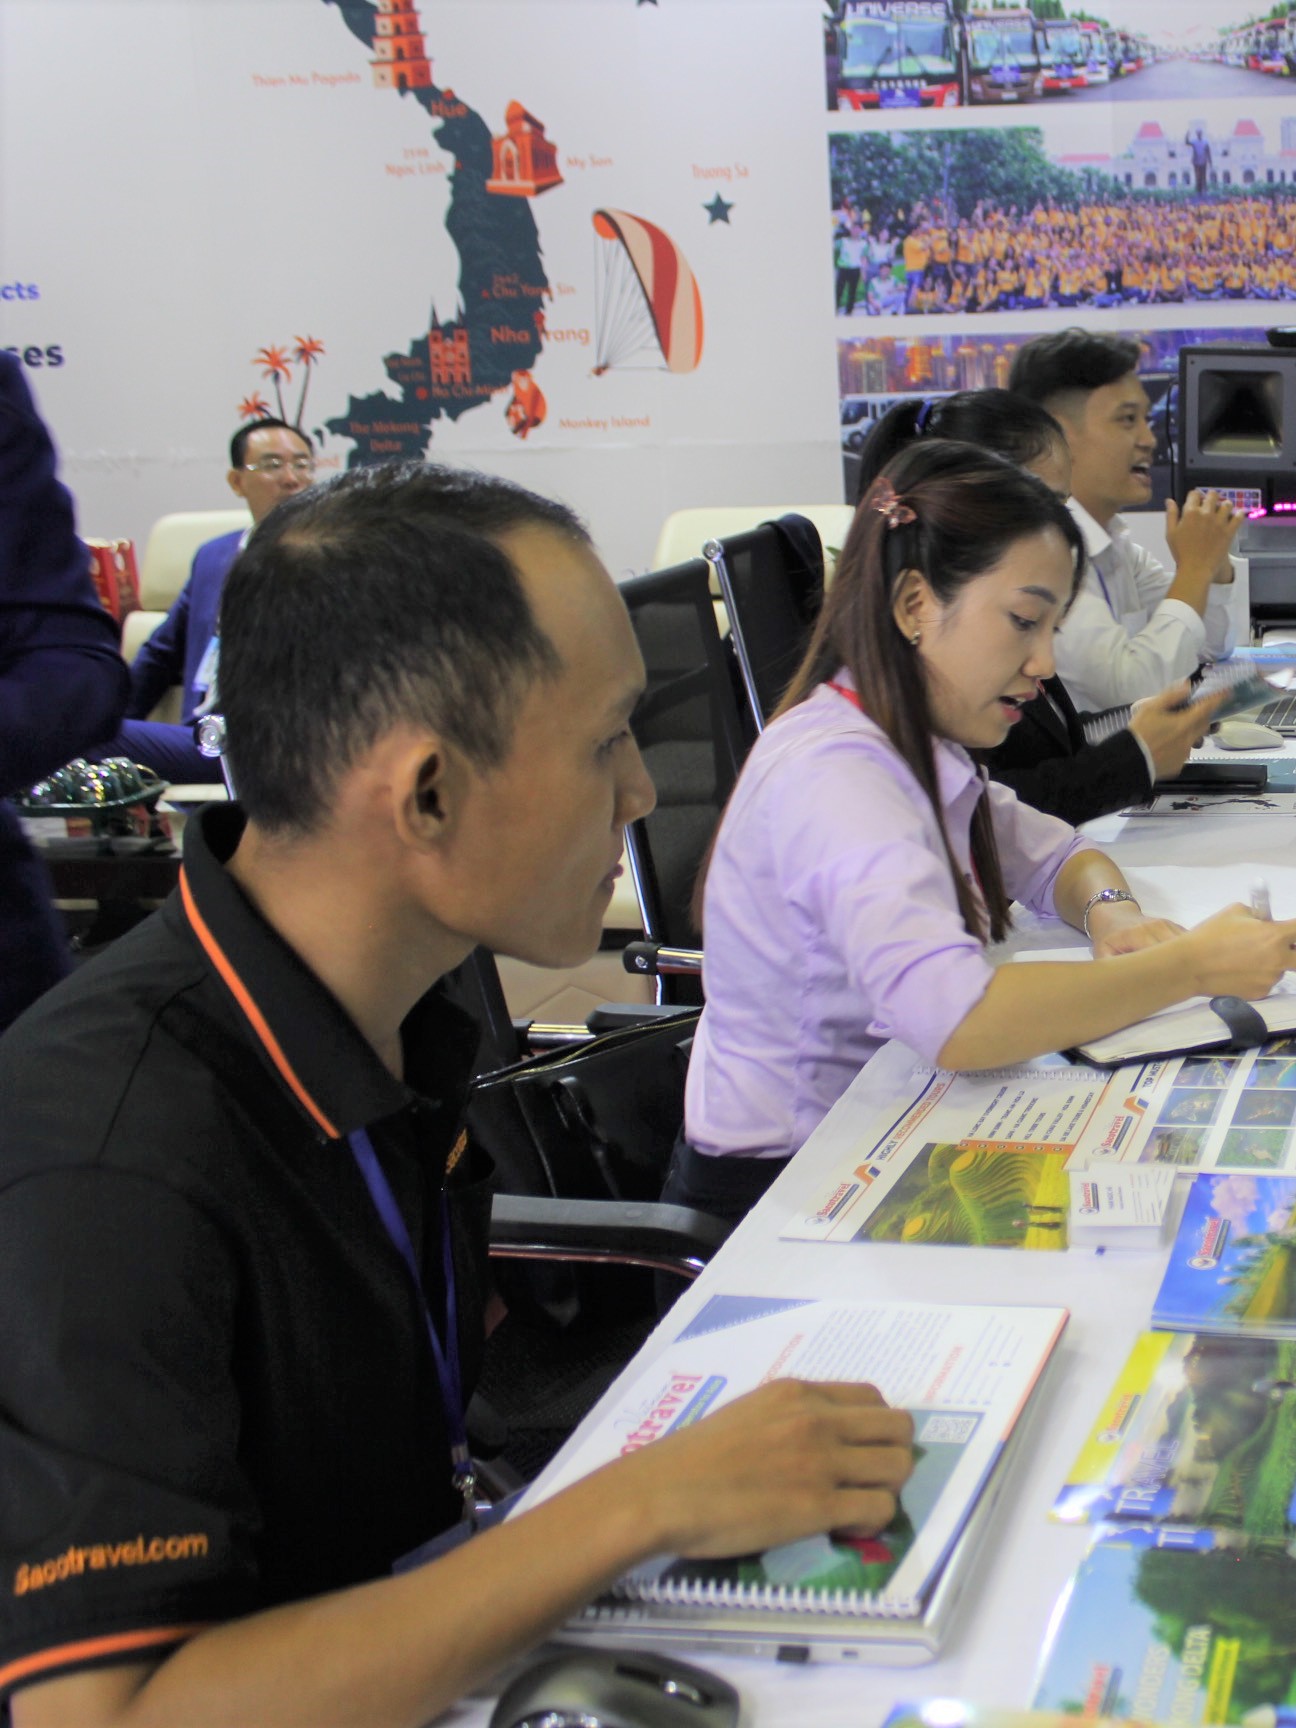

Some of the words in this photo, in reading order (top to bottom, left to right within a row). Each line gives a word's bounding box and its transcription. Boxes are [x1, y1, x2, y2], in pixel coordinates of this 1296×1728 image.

[431, 101, 467, 118] Hue
[491, 326, 531, 344] Nha
[537, 325, 591, 346] Trang
[559, 415, 609, 431] Monkey
[611, 414, 651, 429] Island
[1101, 1115, 1125, 1148] Sacotravel
[876, 1139, 898, 1161] HIGHLY
[817, 1183, 852, 1217] Sacotravel
[620, 1374, 703, 1457] otravel
[1181, 1624, 1212, 1683] DELTA
